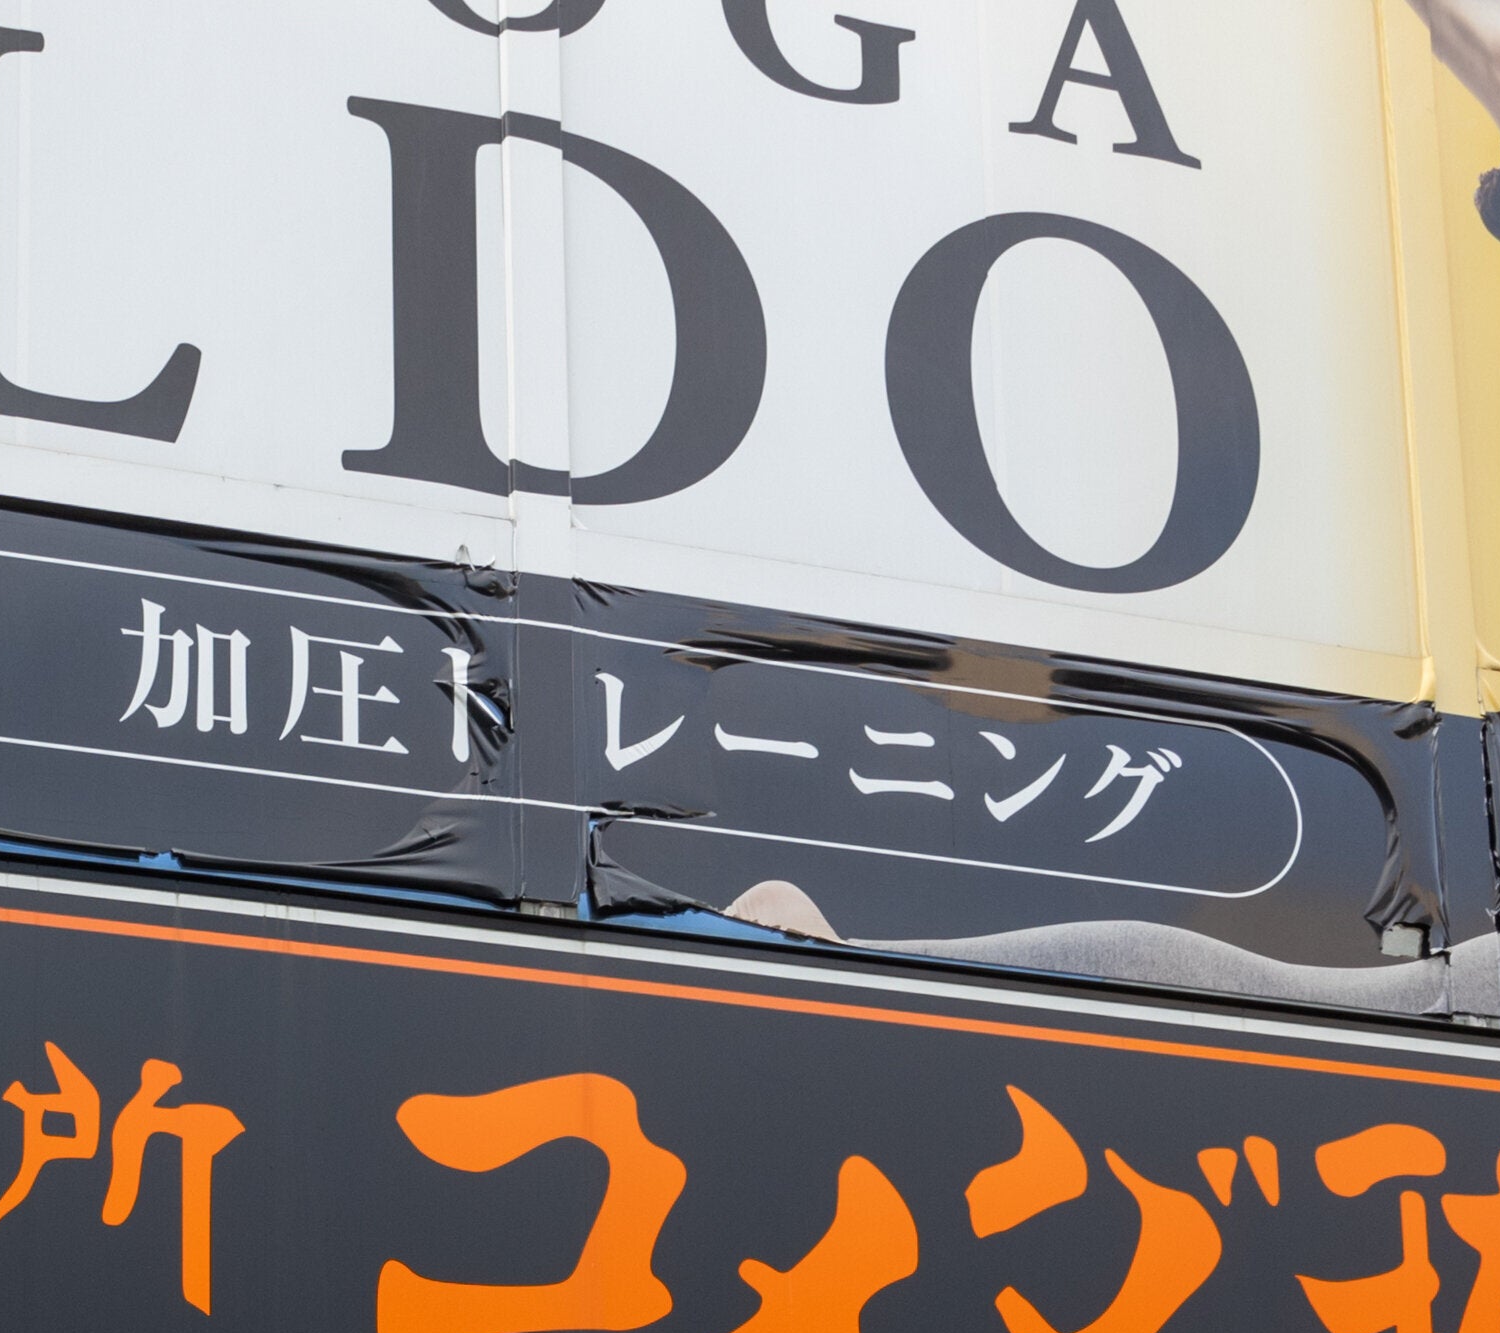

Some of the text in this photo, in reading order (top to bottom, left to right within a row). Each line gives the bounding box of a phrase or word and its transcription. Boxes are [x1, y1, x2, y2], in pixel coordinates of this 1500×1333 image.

[121, 597, 1185, 844] 加圧トレーニング
